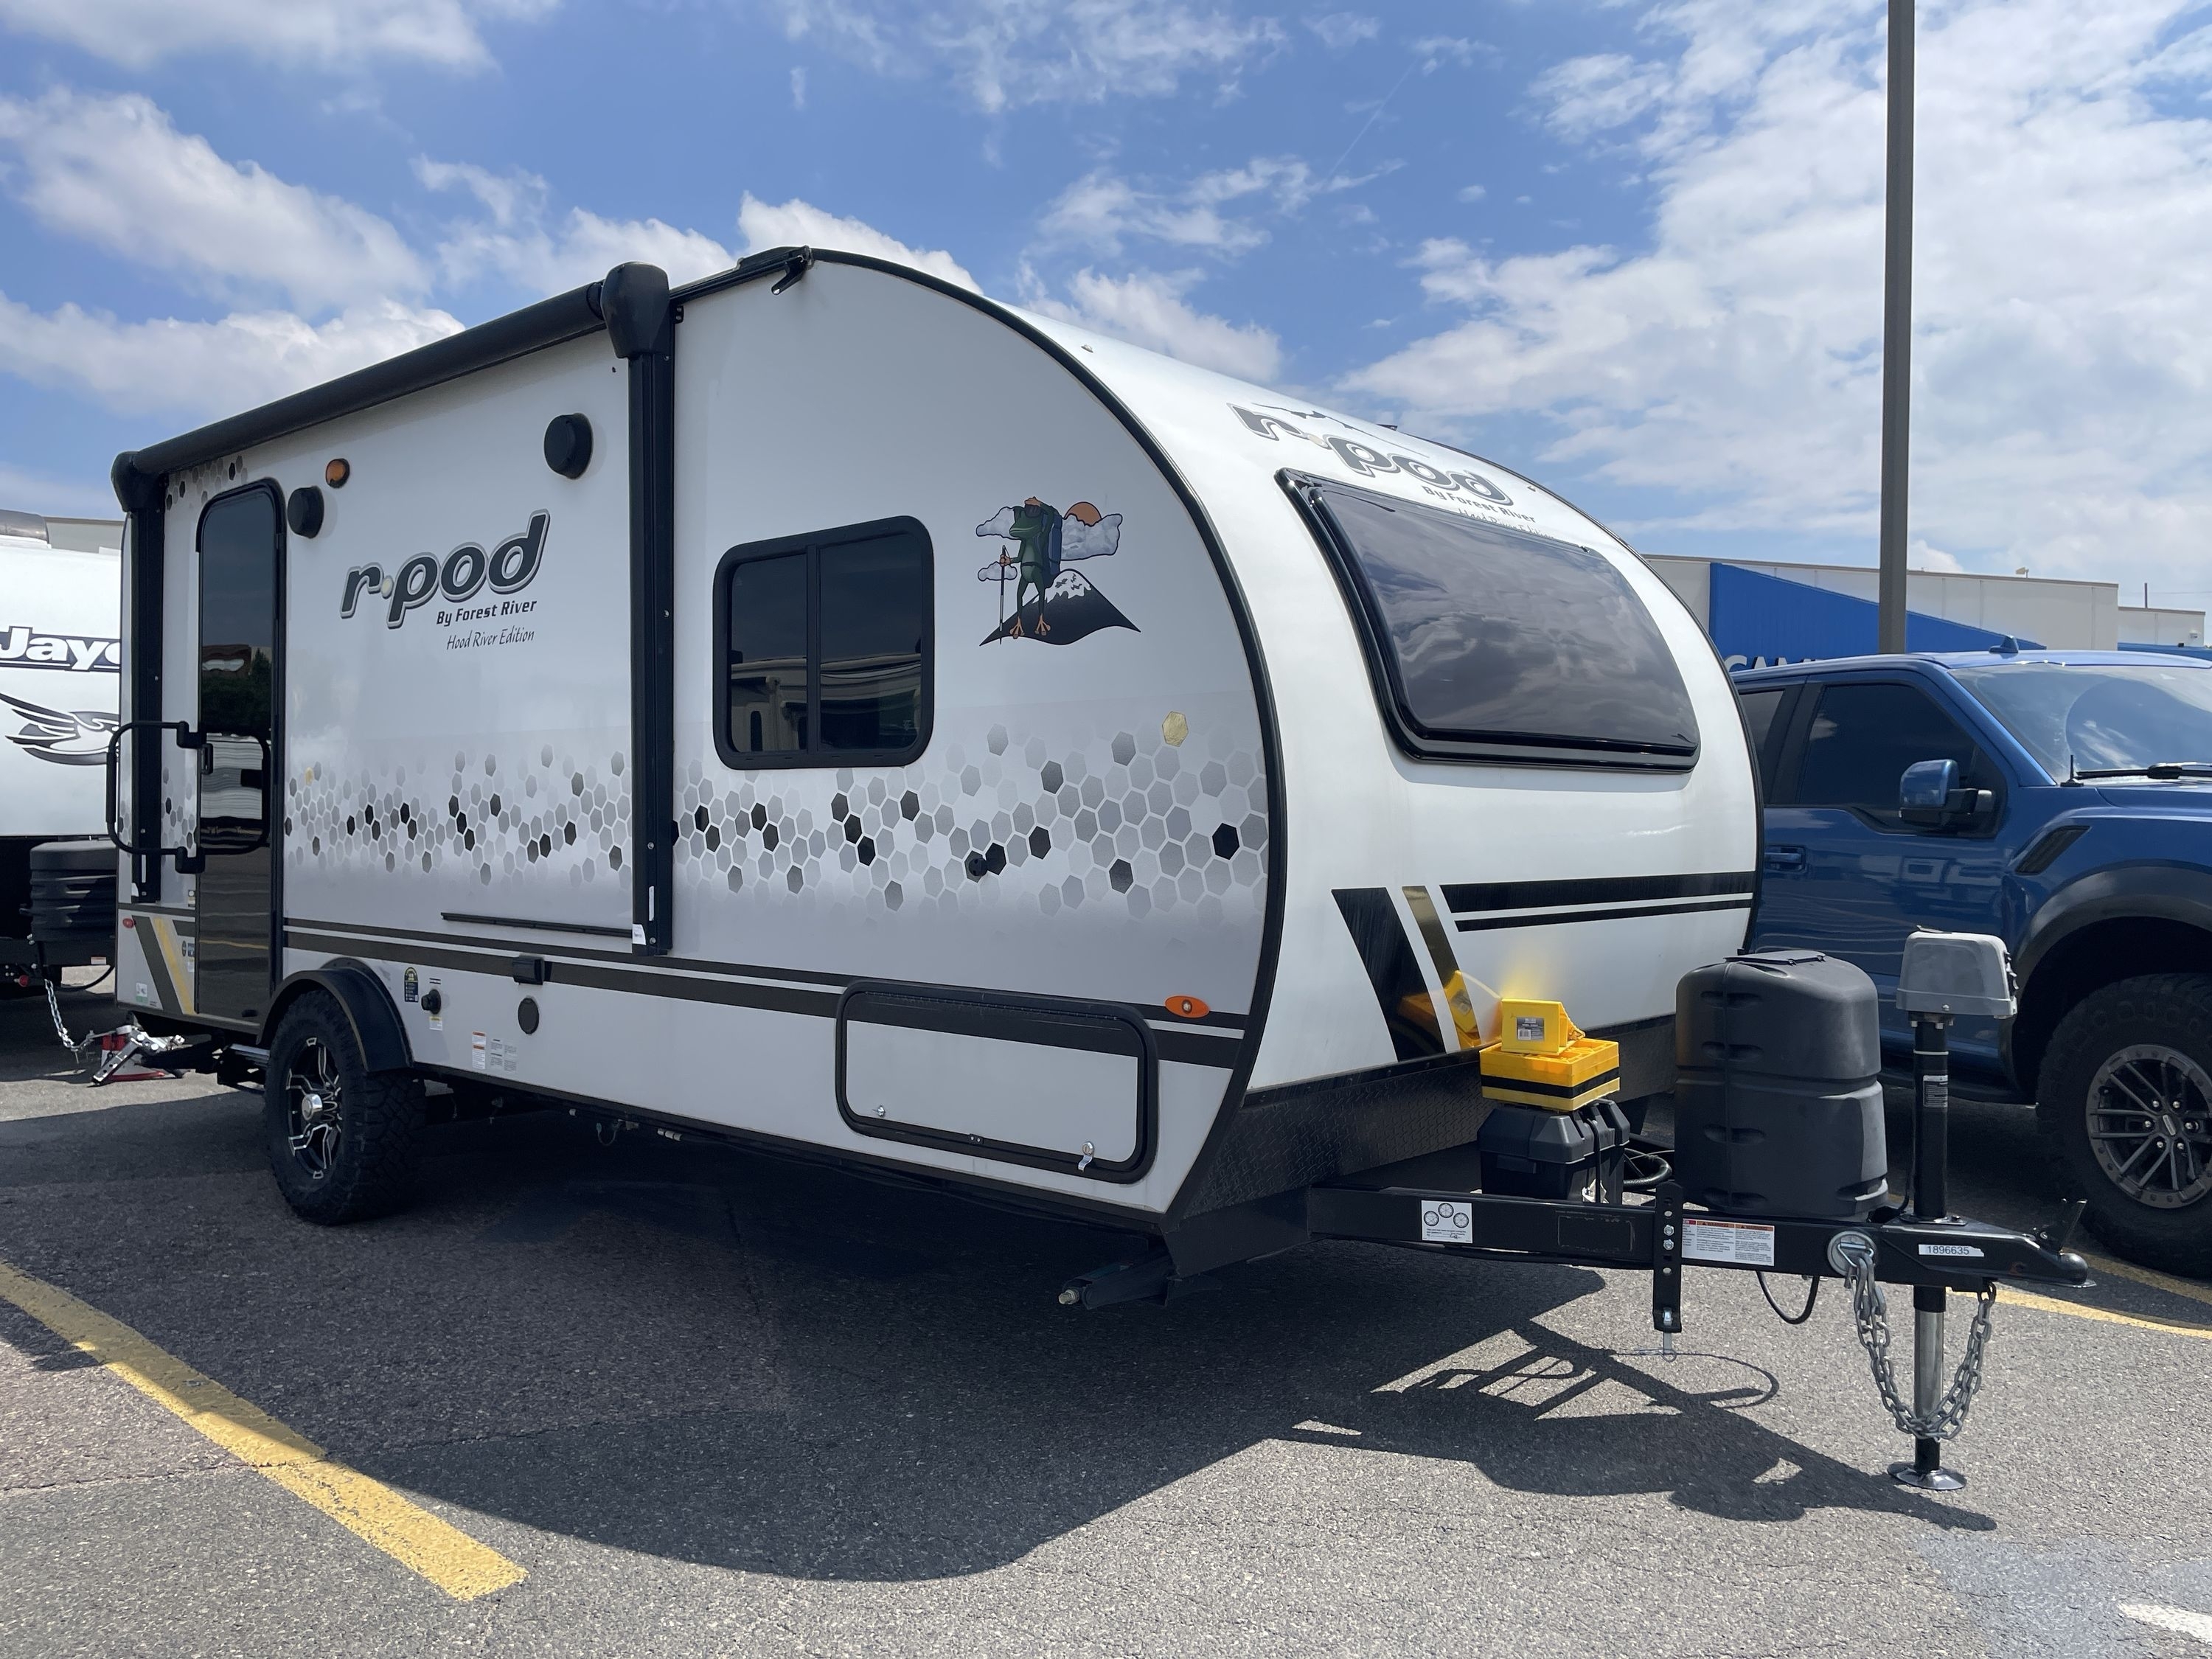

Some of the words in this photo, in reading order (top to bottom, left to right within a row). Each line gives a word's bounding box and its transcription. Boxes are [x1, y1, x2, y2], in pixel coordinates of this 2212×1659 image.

[1422, 485, 1447, 501] By
[1448, 493, 1498, 512] Forest
[1499, 507, 1536, 524] River
[436, 611, 452, 627] By
[455, 605, 498, 622] Forest
[501, 601, 537, 615] River
[446, 630, 473, 650] Hood
[473, 631, 498, 648] River
[498, 625, 535, 645] Edition
[1927, 1245, 1969, 1255] 1896635
